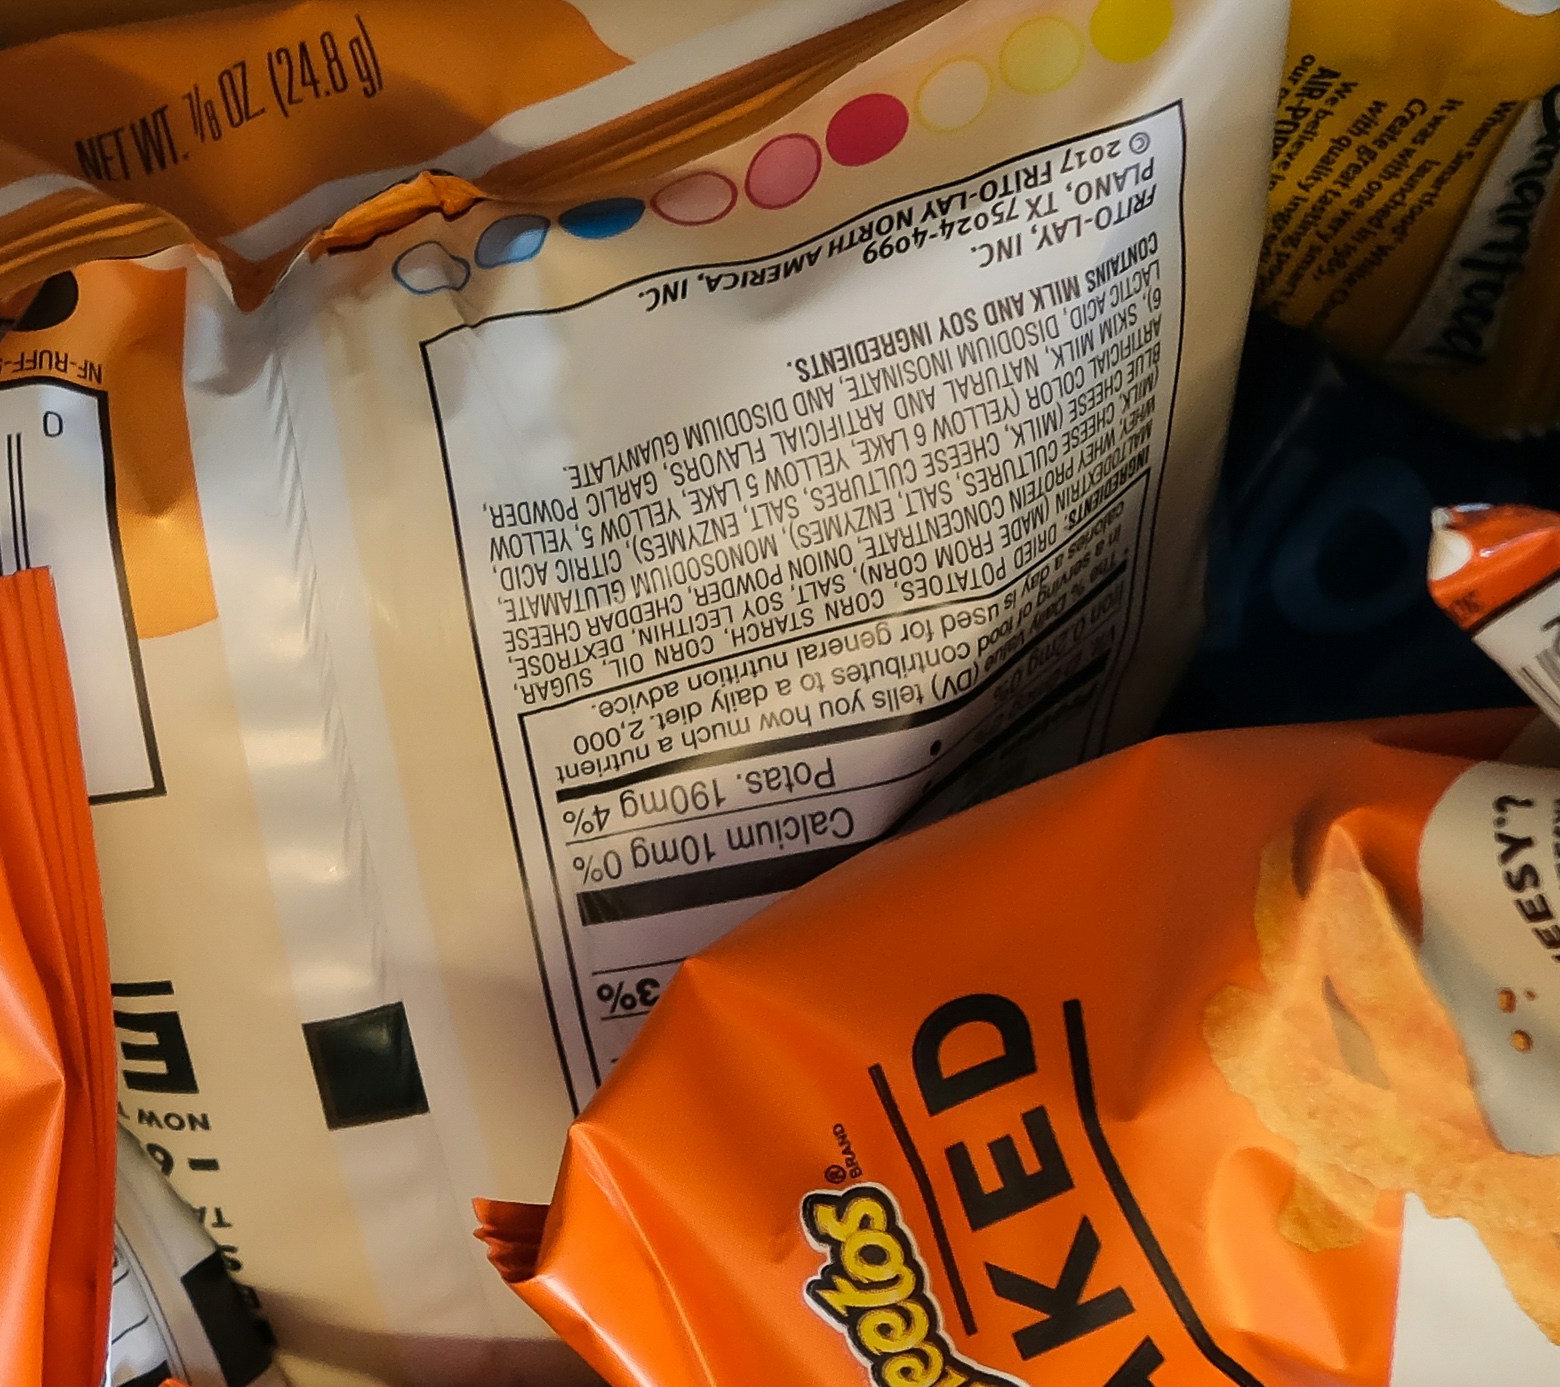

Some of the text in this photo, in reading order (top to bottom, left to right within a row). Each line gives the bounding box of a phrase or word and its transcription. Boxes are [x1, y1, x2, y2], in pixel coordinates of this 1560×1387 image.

[76, 62, 265, 183] NET WT. OZ
[637, 139, 1121, 313] 2017 FRITO-LAY NORTH AMERICA, INC.
[861, 156, 1156, 263] PLANO, TX 75024-4099
[971, 185, 1156, 269] FRITO-LAY, INC.
[562, 757, 836, 836] Potas. 190mg 4%
